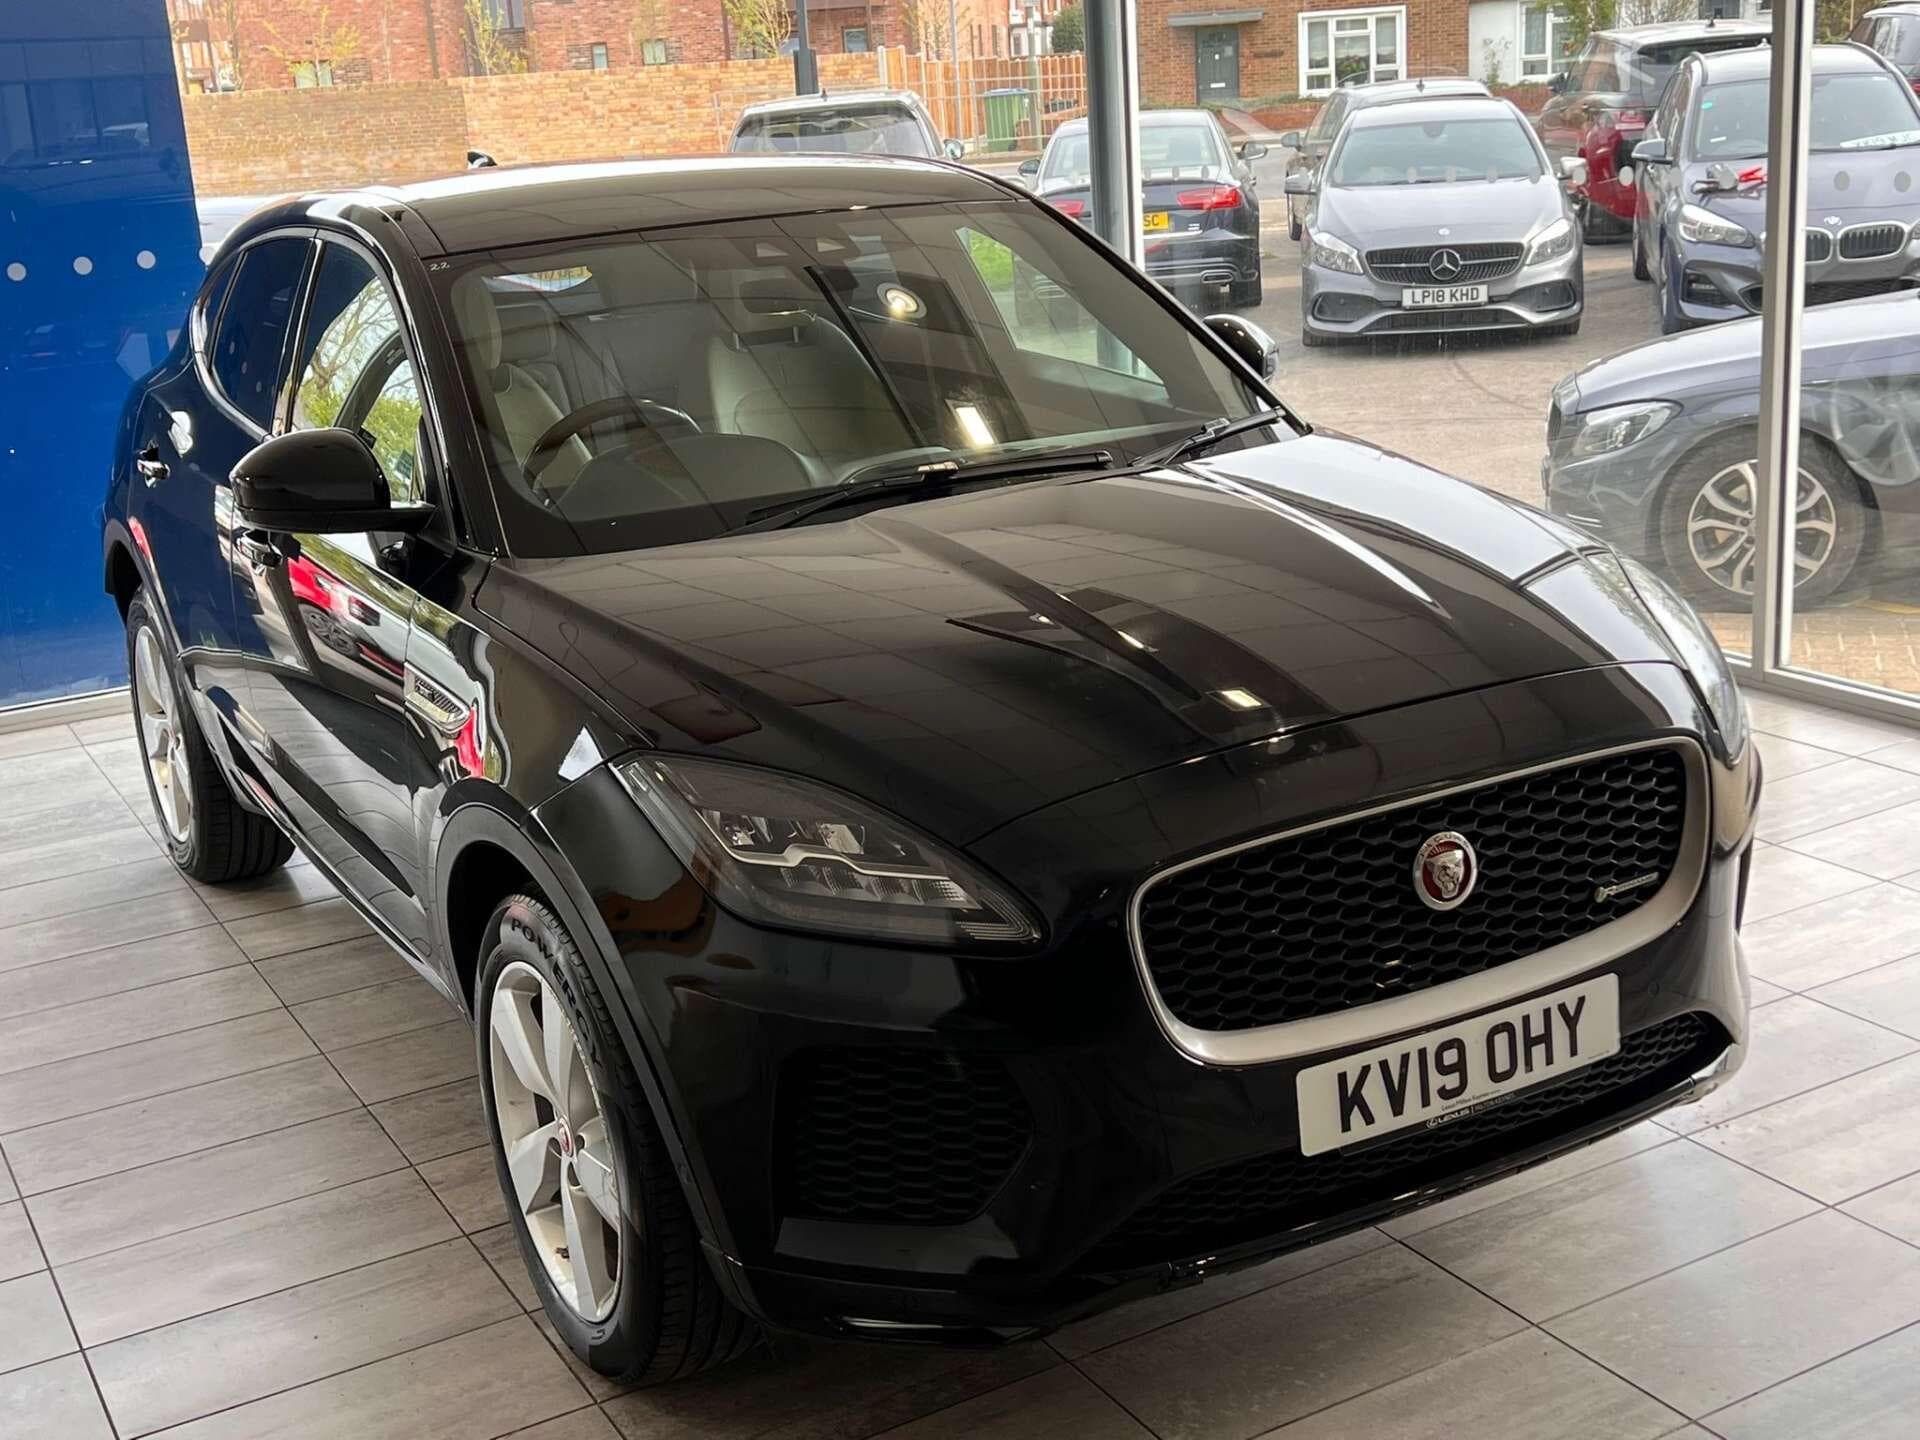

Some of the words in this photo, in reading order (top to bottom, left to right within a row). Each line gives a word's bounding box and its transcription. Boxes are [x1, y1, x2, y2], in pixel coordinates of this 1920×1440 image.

[1143, 214, 1160, 227] SC
[1412, 289, 1445, 304] LP18
[1450, 287, 1479, 302] KHD
[1336, 1037, 1468, 1134] KV19
[1486, 995, 1586, 1084] OHY
